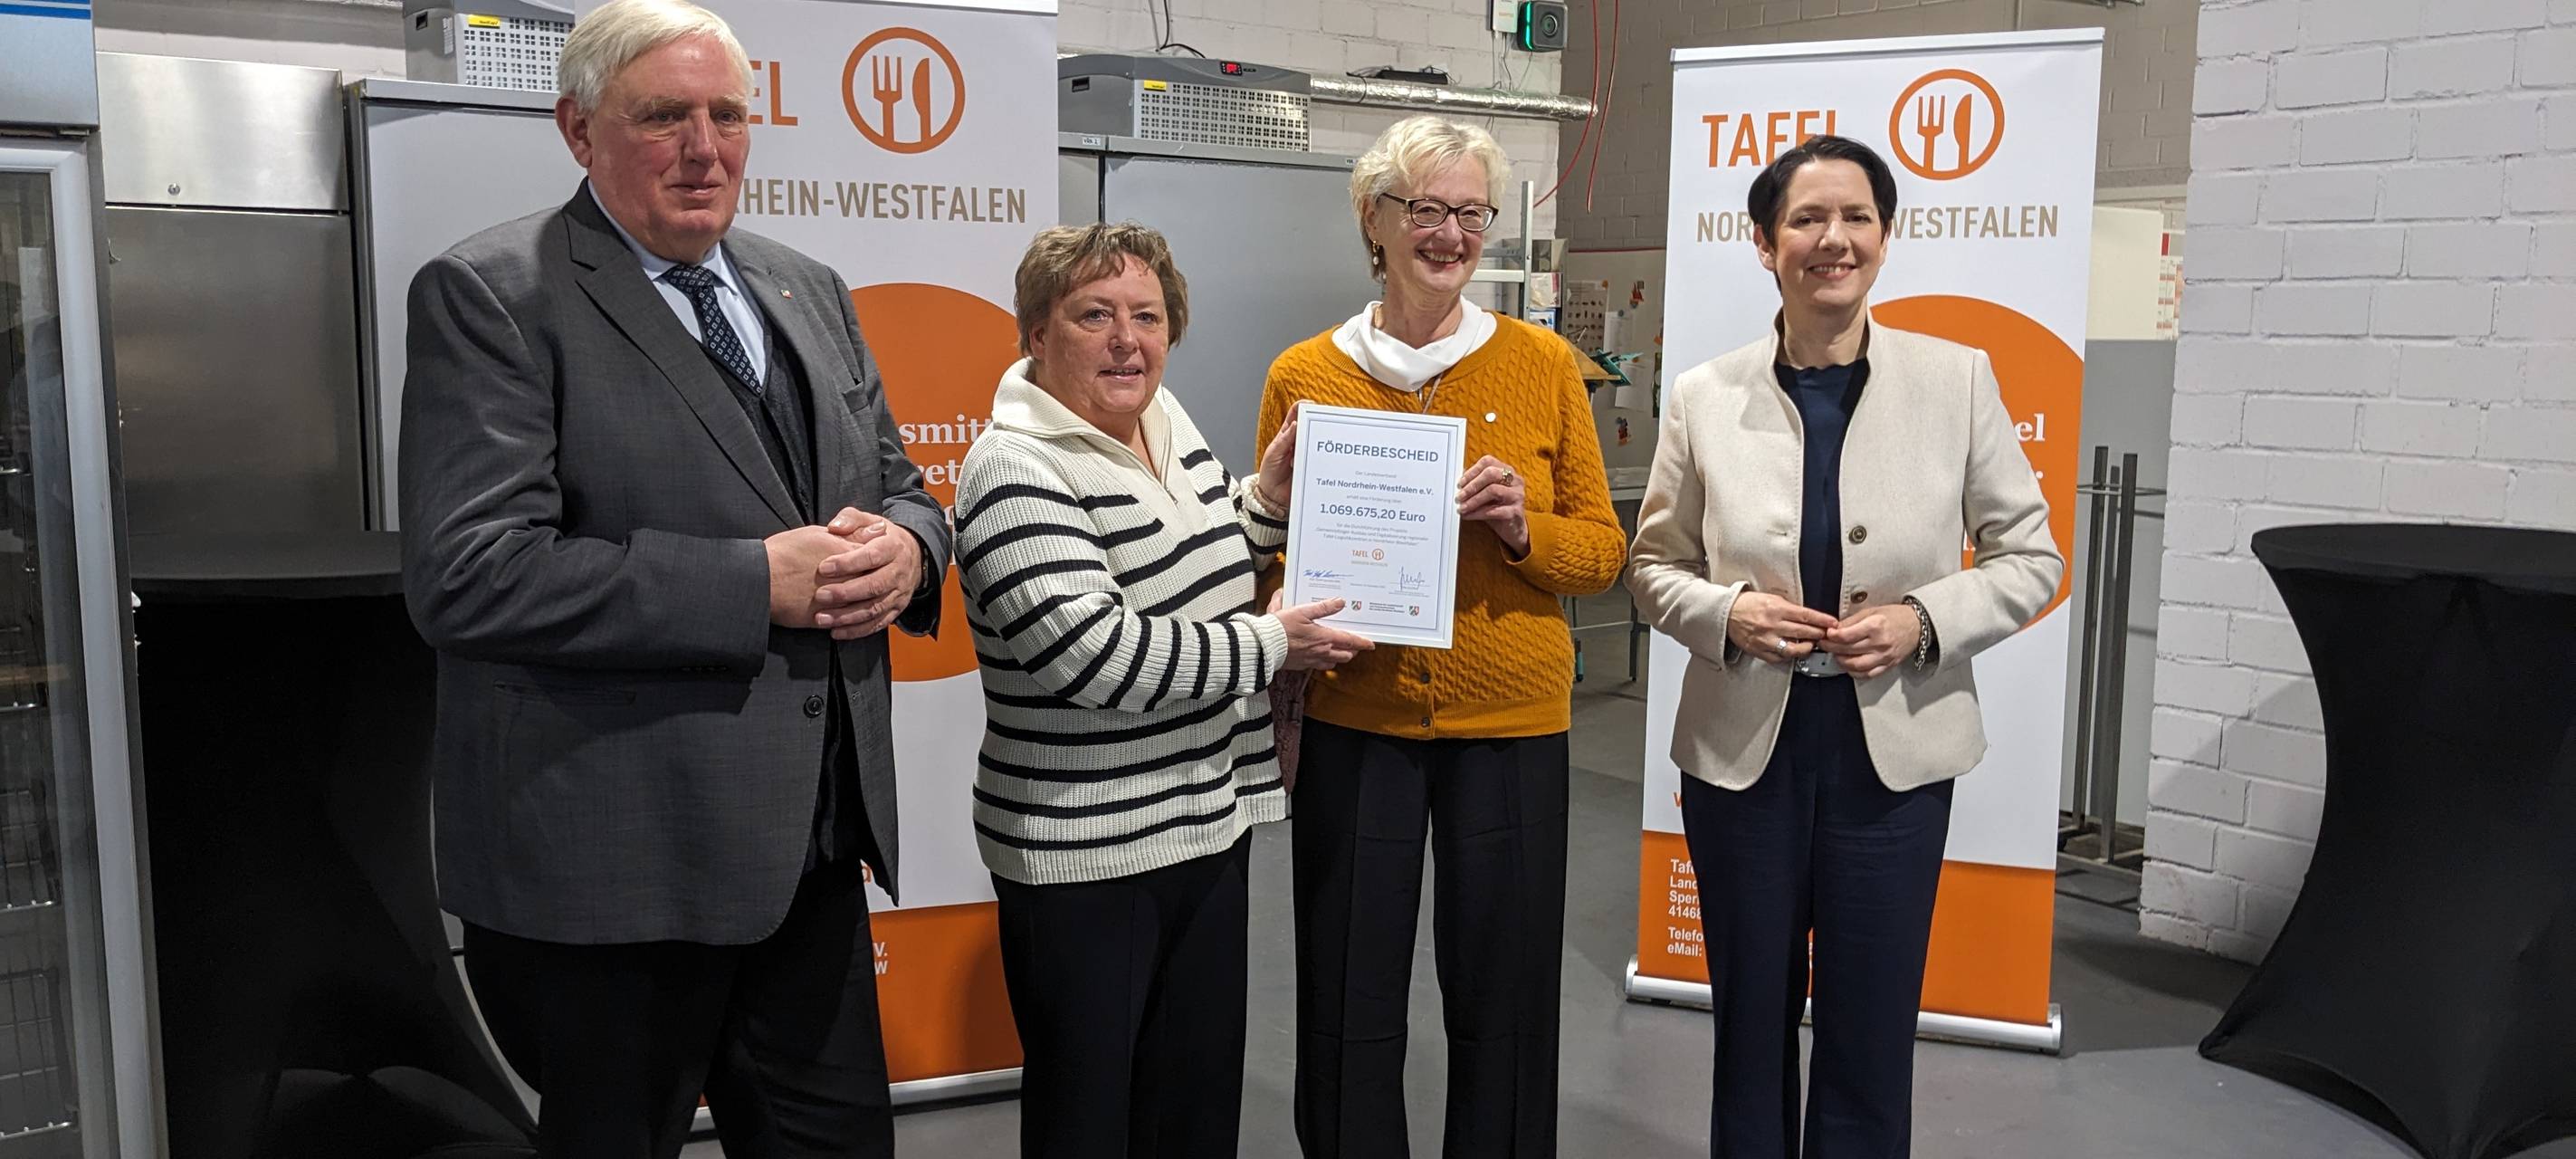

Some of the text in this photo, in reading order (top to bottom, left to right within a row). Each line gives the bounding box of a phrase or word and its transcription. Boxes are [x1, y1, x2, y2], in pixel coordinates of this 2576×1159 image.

[735, 178, 1026, 224] HEIN-WESTFALEN
[1317, 440, 1439, 463] FÖRDERBESCHEID
[1316, 478, 1435, 496] Tafel Nordrhein-Westfalen e.V.
[1320, 503, 1426, 522] 1.069.675,20 Euro
[1352, 550, 1369, 559] TAFEL
[1667, 942, 1703, 957] eMail:
